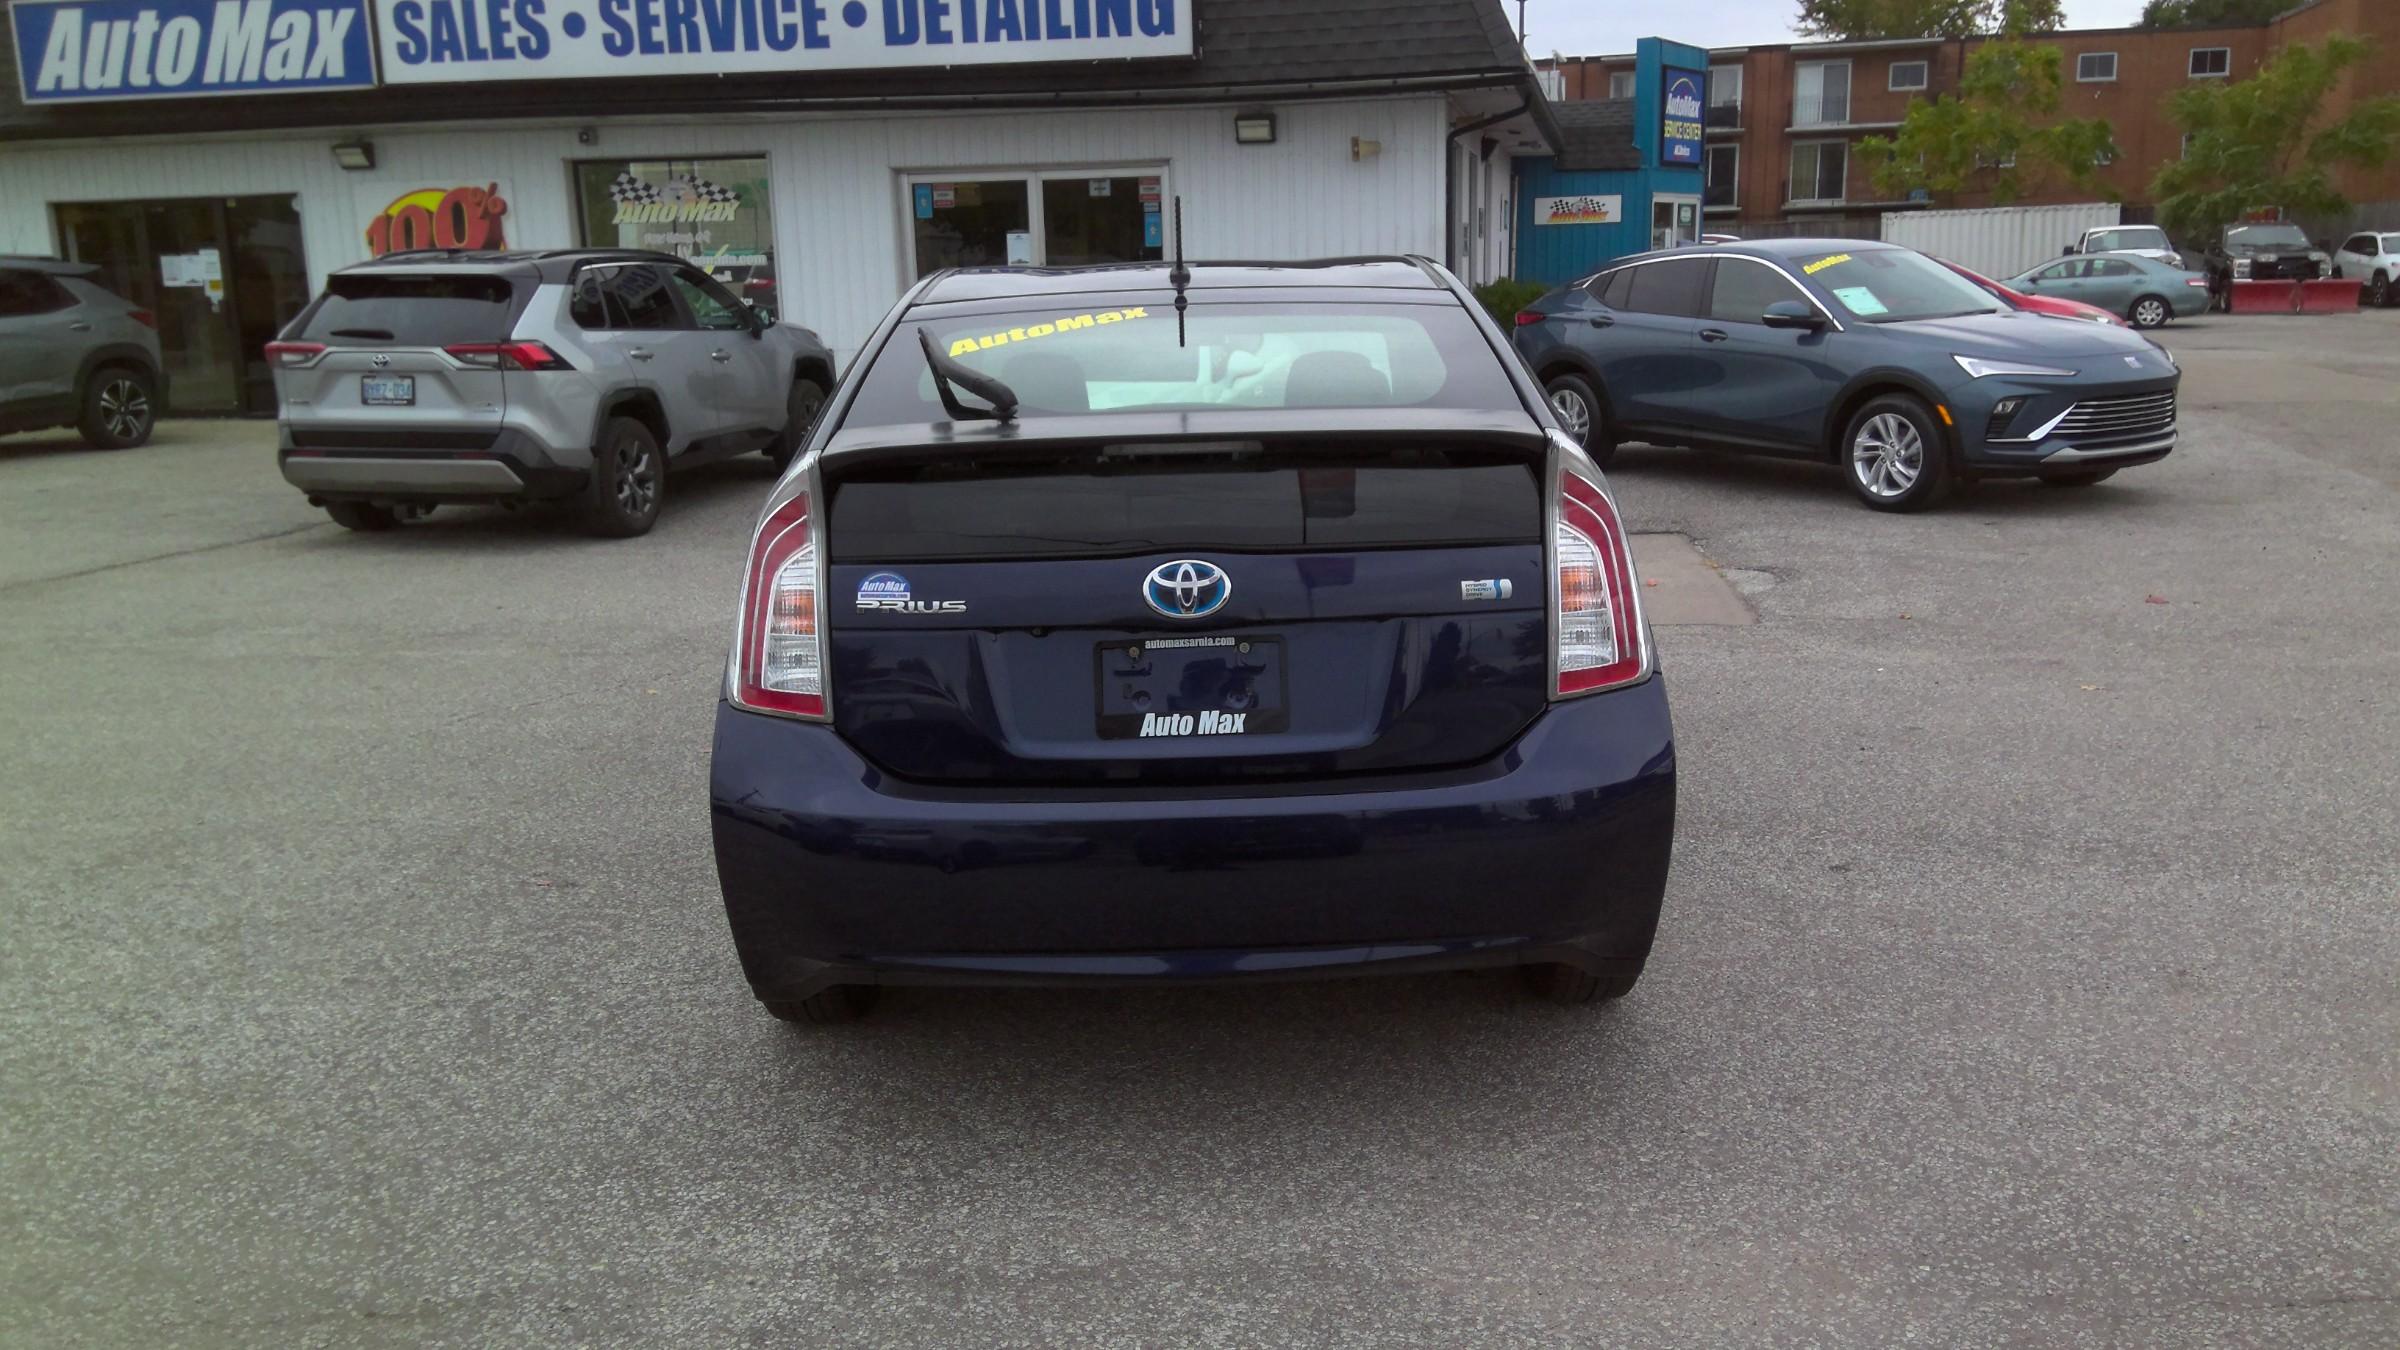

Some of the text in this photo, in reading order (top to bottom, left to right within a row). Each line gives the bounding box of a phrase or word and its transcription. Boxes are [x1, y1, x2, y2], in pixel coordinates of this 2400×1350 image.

[393, 0, 1176, 64] SALES SERVICE DETAILING
[949, 307, 1148, 357] AutoMax
[856, 600, 967, 614] PRIUS
[1145, 636, 1235, 650] automaxsarnia.com
[1139, 710, 1247, 737] Auto Max
